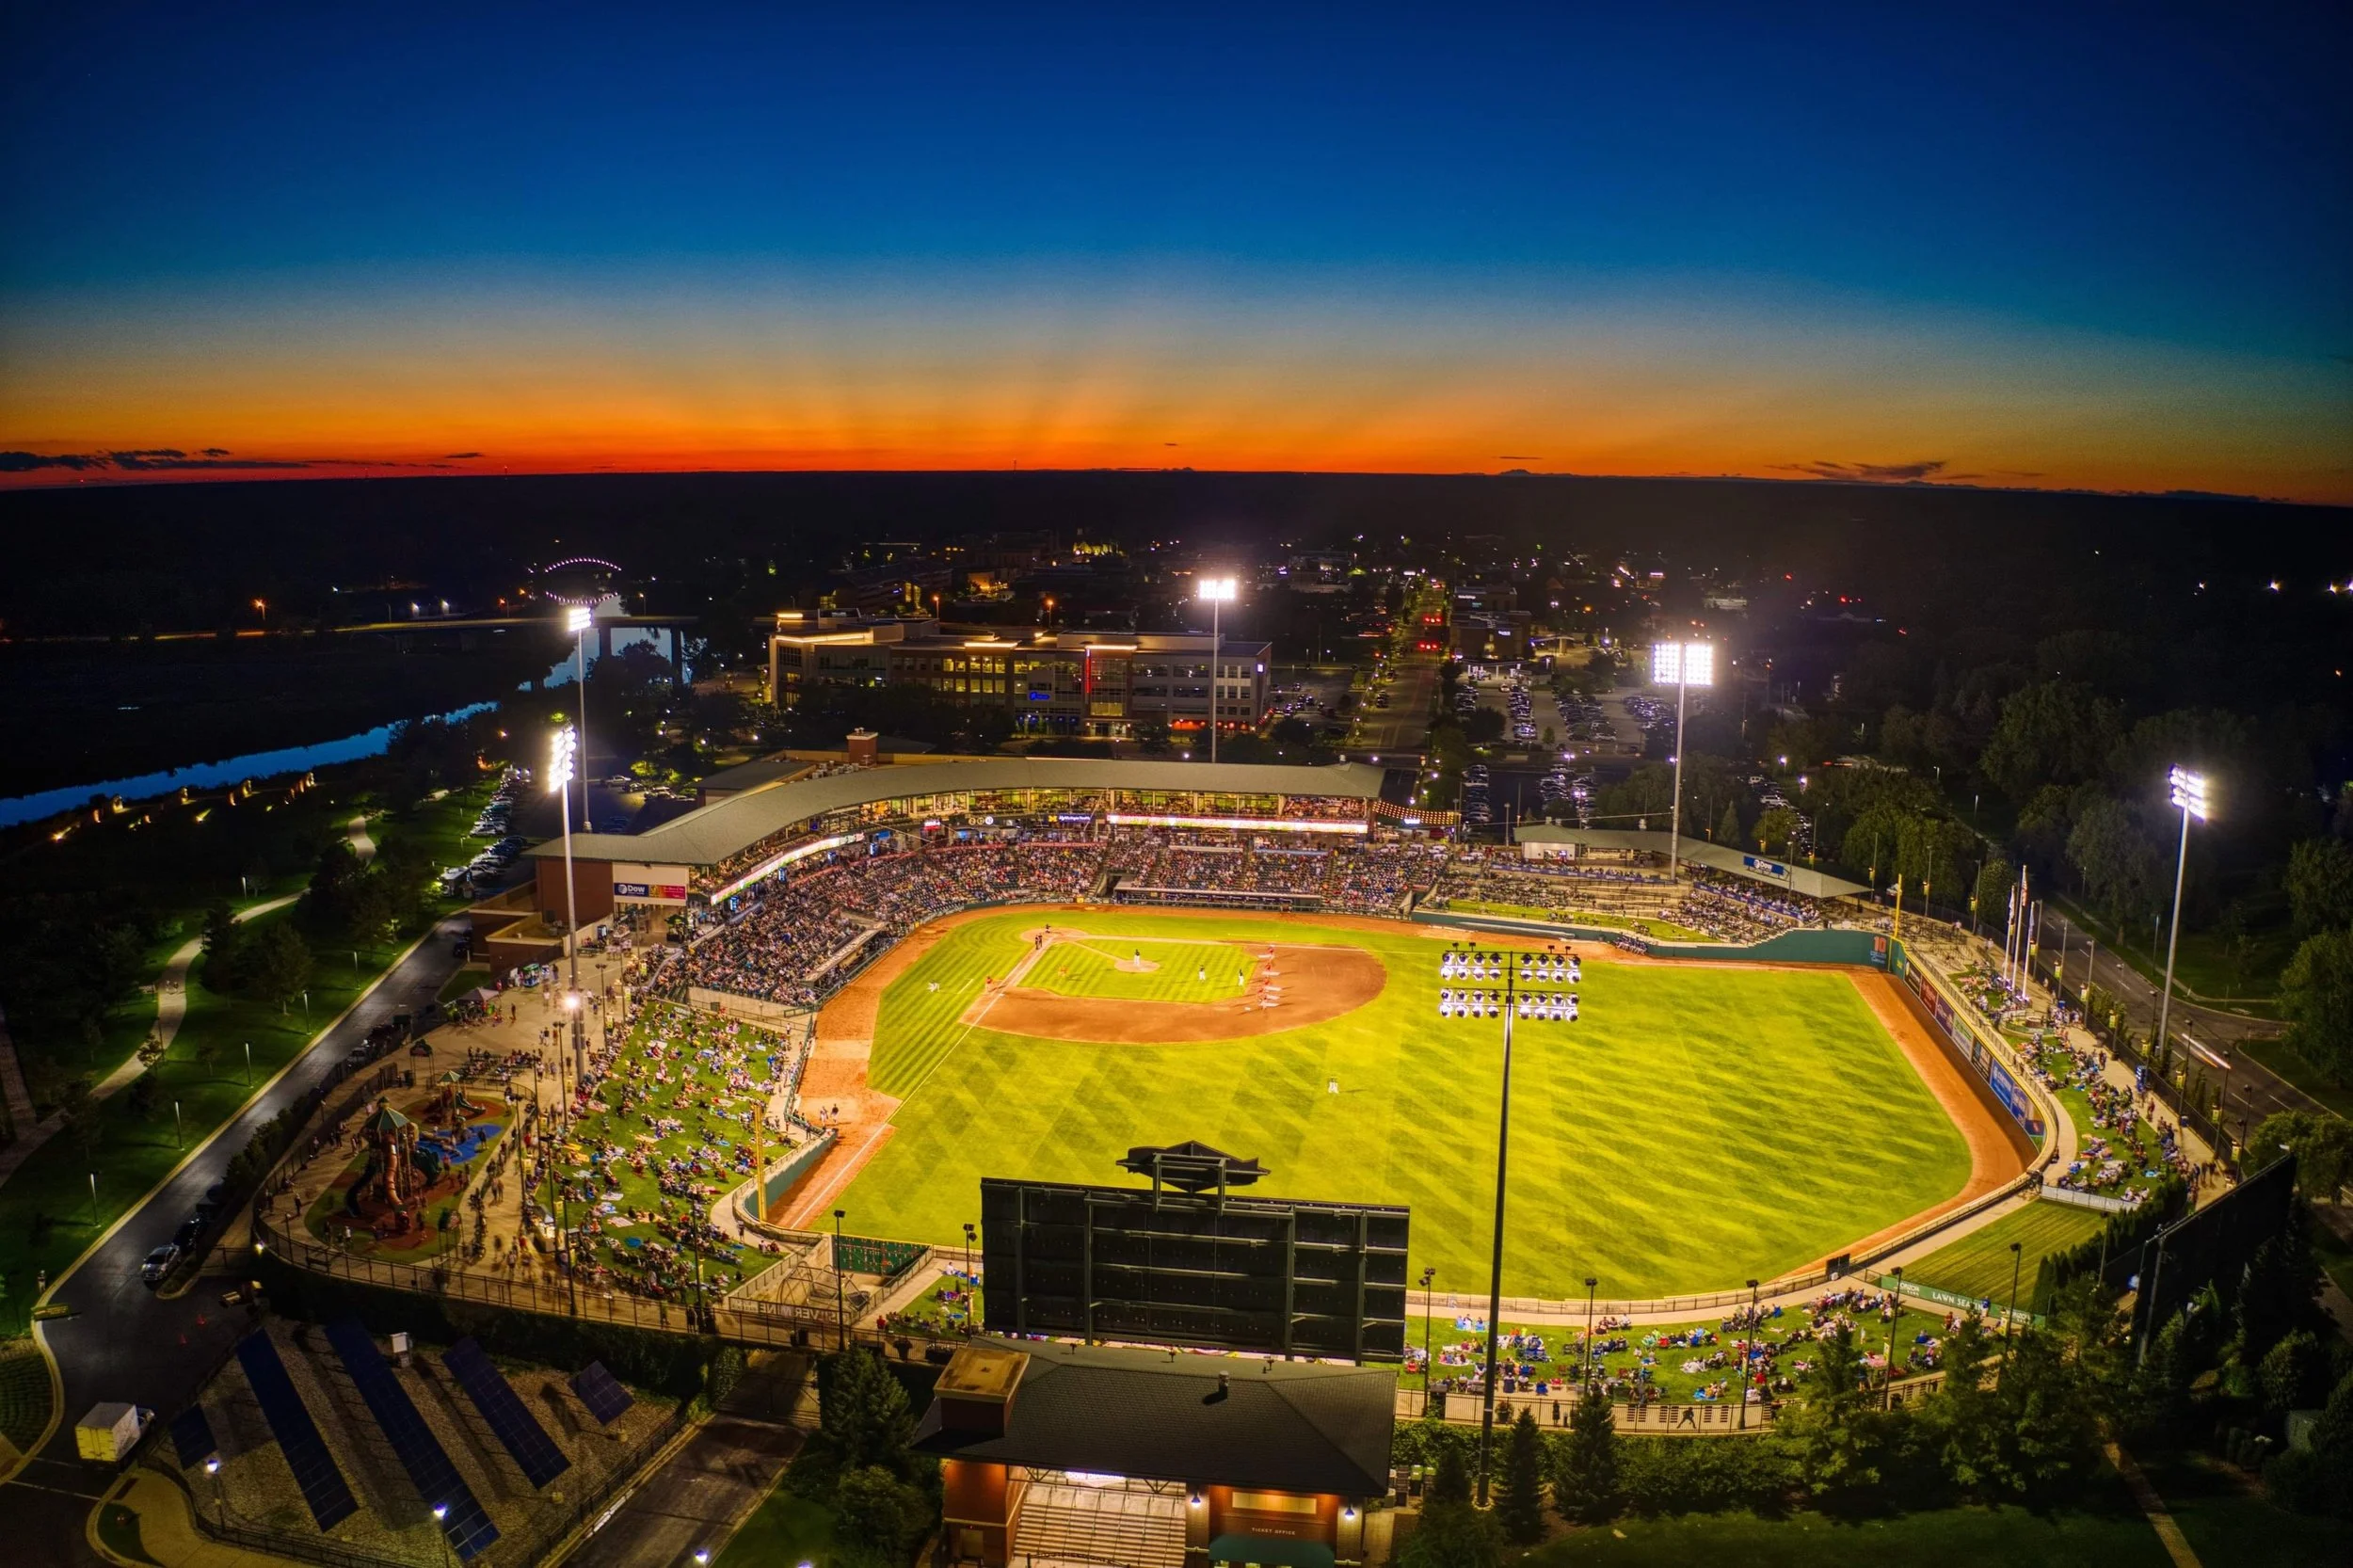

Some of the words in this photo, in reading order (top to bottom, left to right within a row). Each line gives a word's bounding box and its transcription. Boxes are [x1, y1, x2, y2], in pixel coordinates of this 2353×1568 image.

[1874, 936, 1887, 952] 10
[1932, 1291, 1956, 1304] LAWN
[1958, 1298, 1983, 1311] SEAIN
